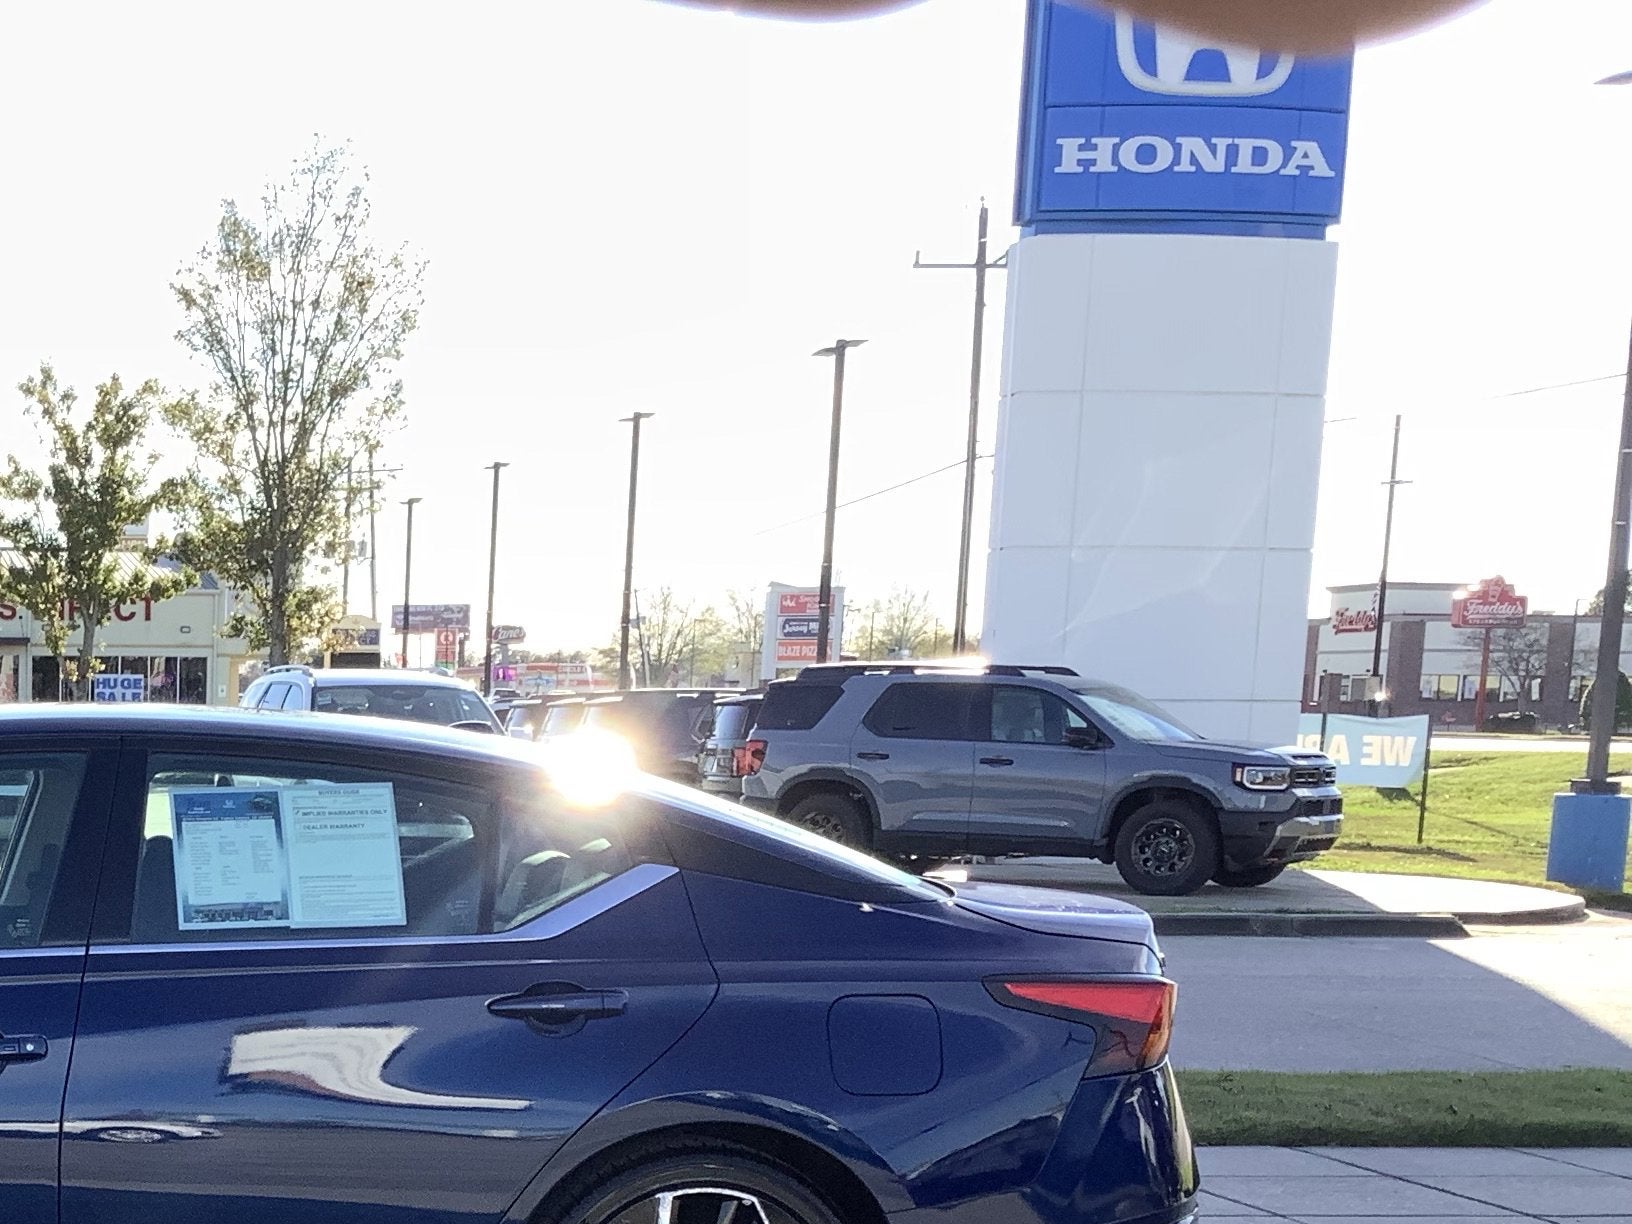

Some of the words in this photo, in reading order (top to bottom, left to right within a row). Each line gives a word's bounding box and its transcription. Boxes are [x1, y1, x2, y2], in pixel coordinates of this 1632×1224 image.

[1053, 135, 1336, 178] HONDA
[1463, 600, 1524, 618] Freddy's
[96, 678, 143, 690] HUGE
